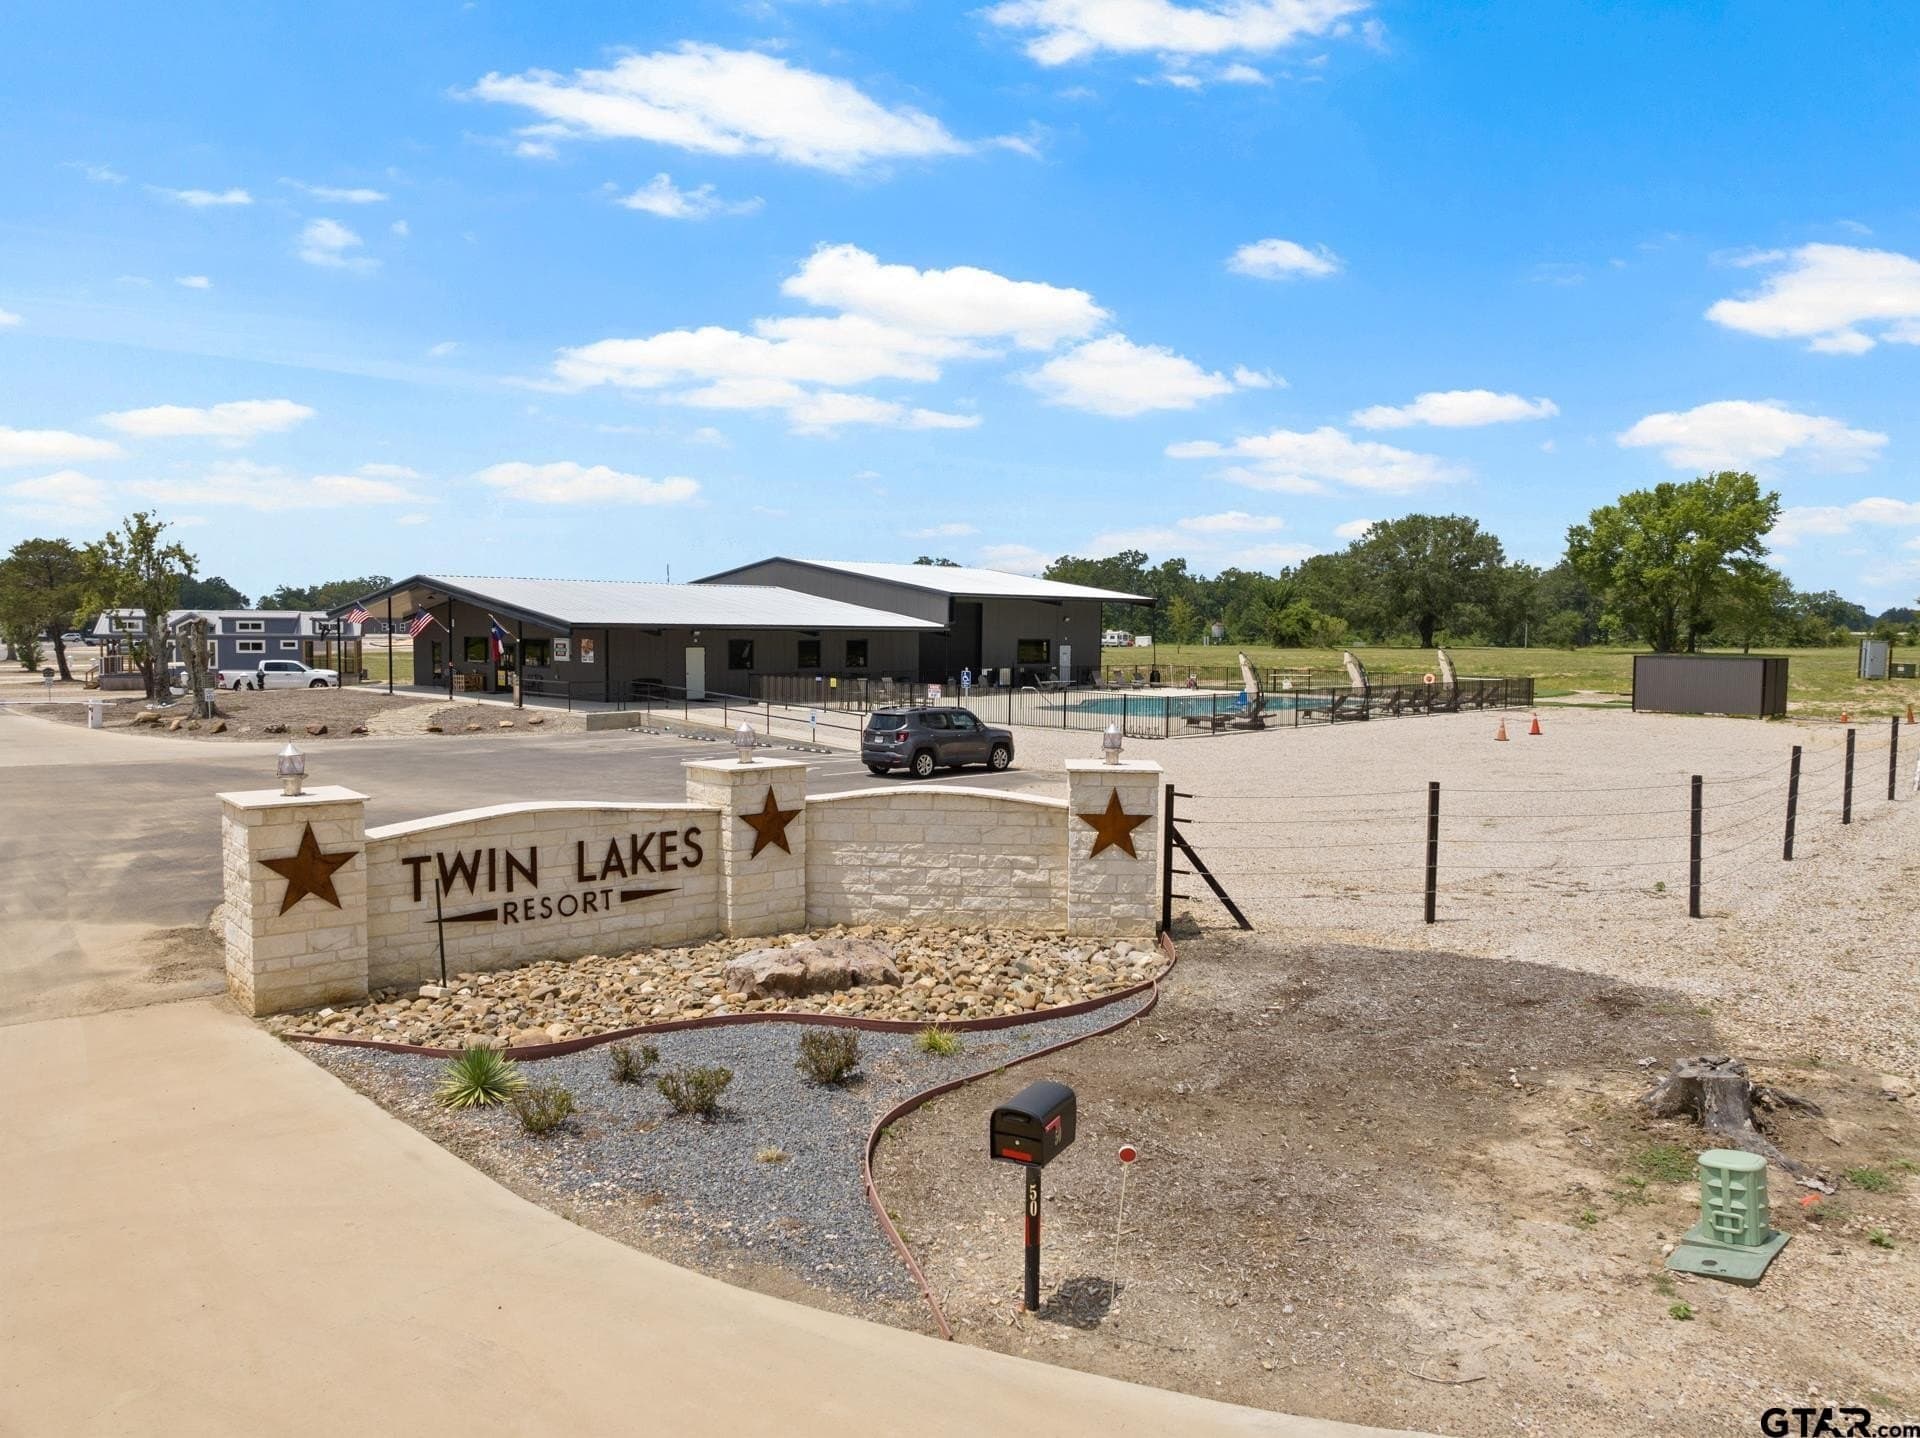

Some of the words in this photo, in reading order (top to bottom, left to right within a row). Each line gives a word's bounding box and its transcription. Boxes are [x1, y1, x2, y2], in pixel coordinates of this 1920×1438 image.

[401, 846, 538, 902] TWIN
[576, 826, 704, 883] LAKES
[503, 889, 614, 925] RESORT
